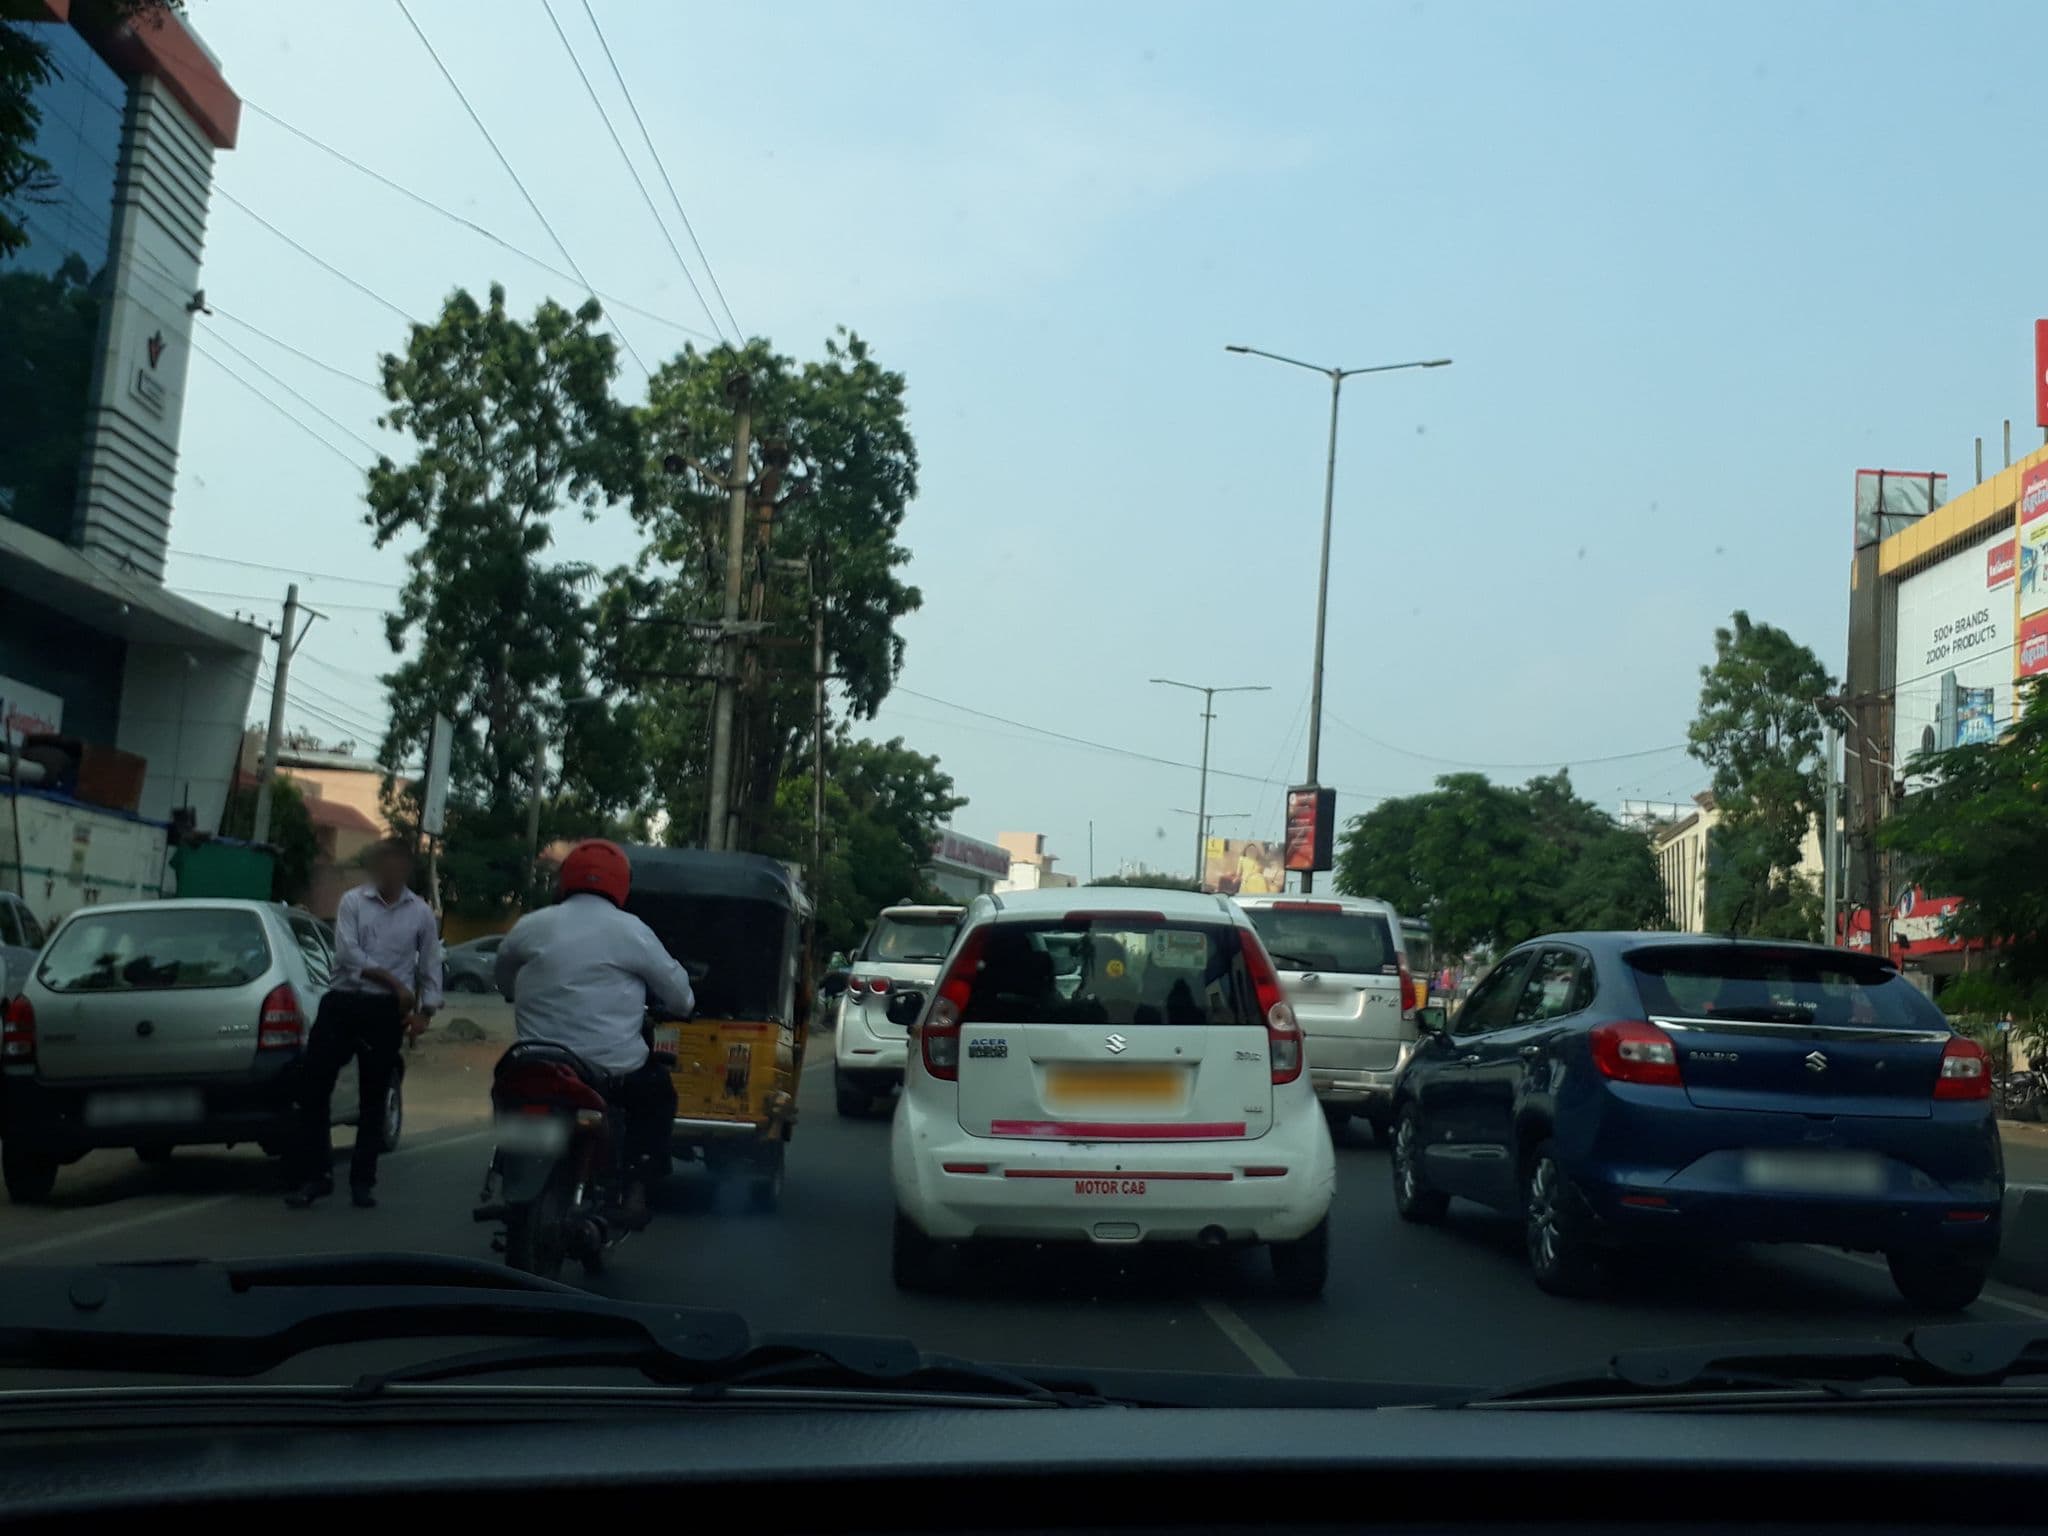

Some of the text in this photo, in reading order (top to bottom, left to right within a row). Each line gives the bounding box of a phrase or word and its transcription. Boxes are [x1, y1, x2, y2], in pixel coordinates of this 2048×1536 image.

[1933, 608, 1989, 643] 500+ BRANDS
[1952, 624, 1996, 654] PRODUCTS
[971, 1038, 1007, 1046] ACER
[1075, 1180, 1146, 1195] MOTOR CAB
